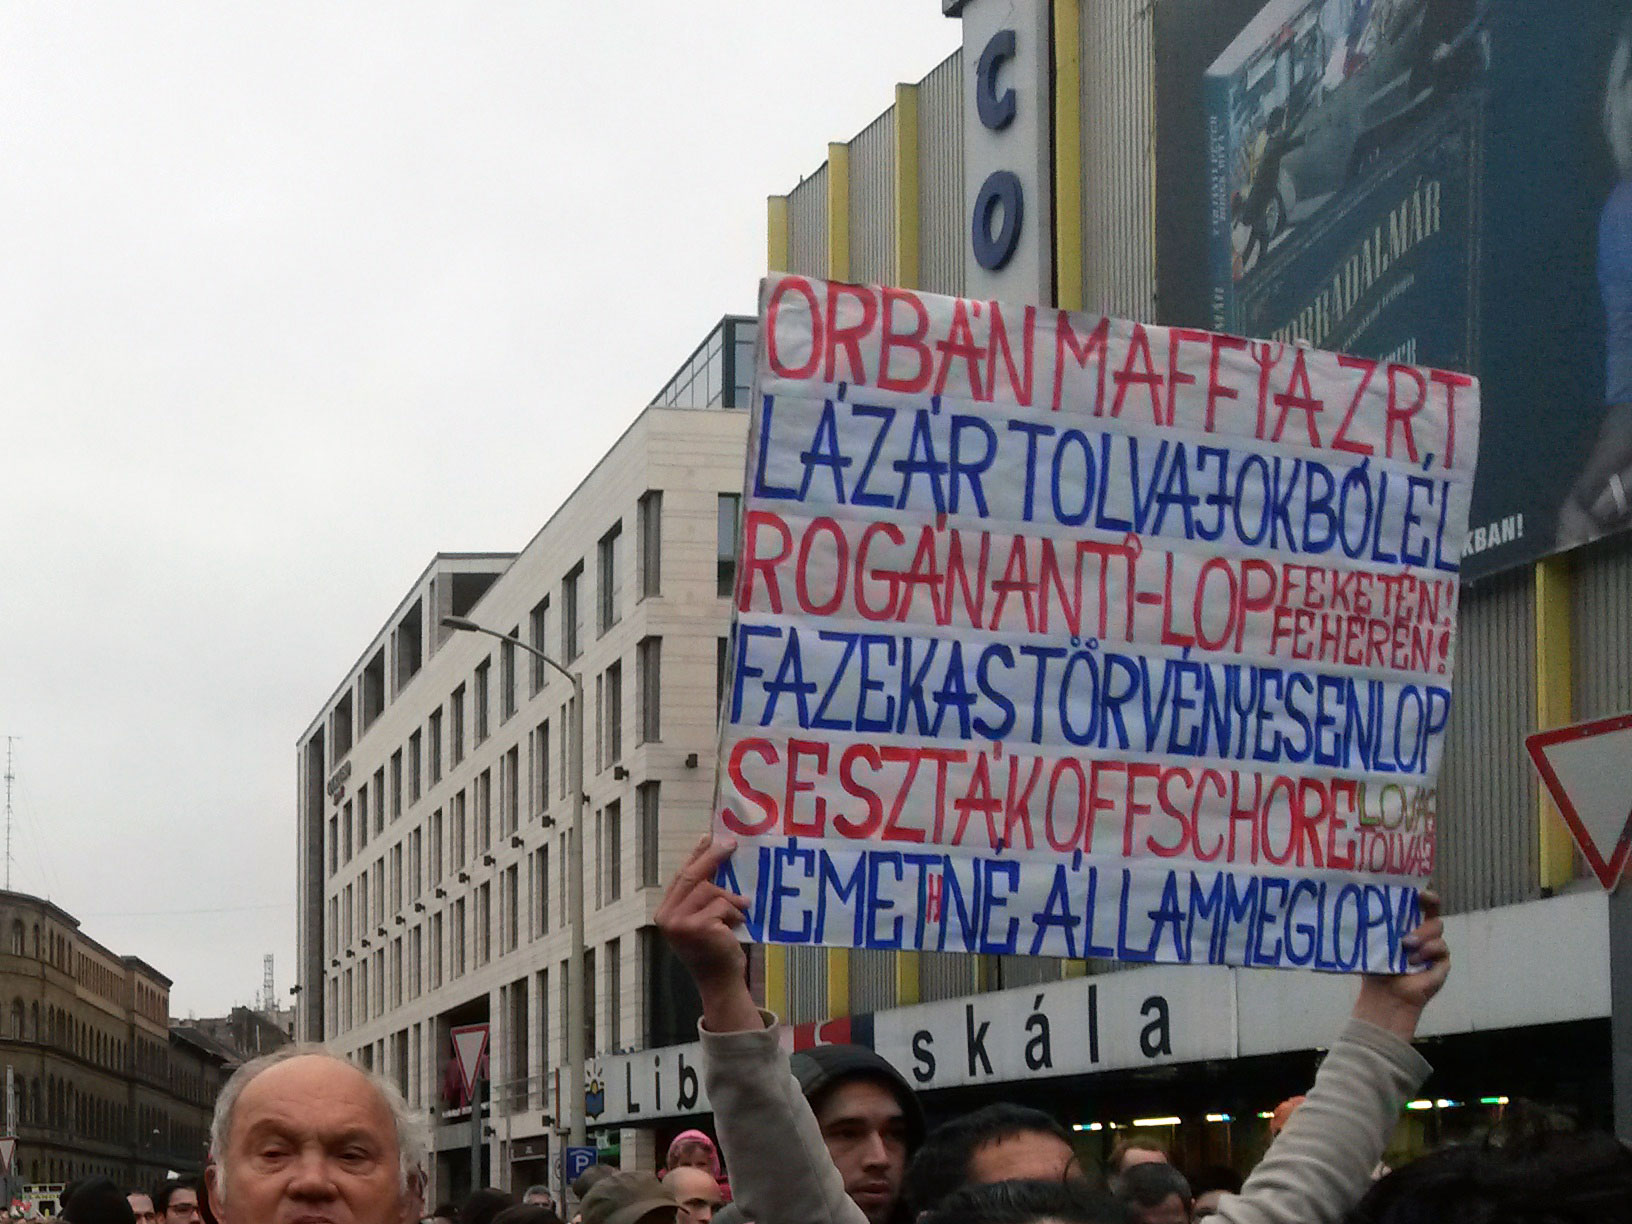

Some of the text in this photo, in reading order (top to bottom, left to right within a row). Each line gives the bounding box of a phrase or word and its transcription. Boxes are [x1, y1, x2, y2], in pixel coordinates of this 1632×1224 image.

[767, 275, 1036, 407] ORBÁN
[1051, 309, 1323, 448] MAFFIA
[1332, 353, 1472, 469] ZRT
[753, 382, 999, 518] LÁZÁR
[738, 509, 991, 629] ROGÁN
[730, 622, 1017, 741] FAZEKAS
[722, 736, 1043, 850] SESZTÁK
[912, 984, 1172, 1083] skála
[575, 1155, 591, 1174] P
